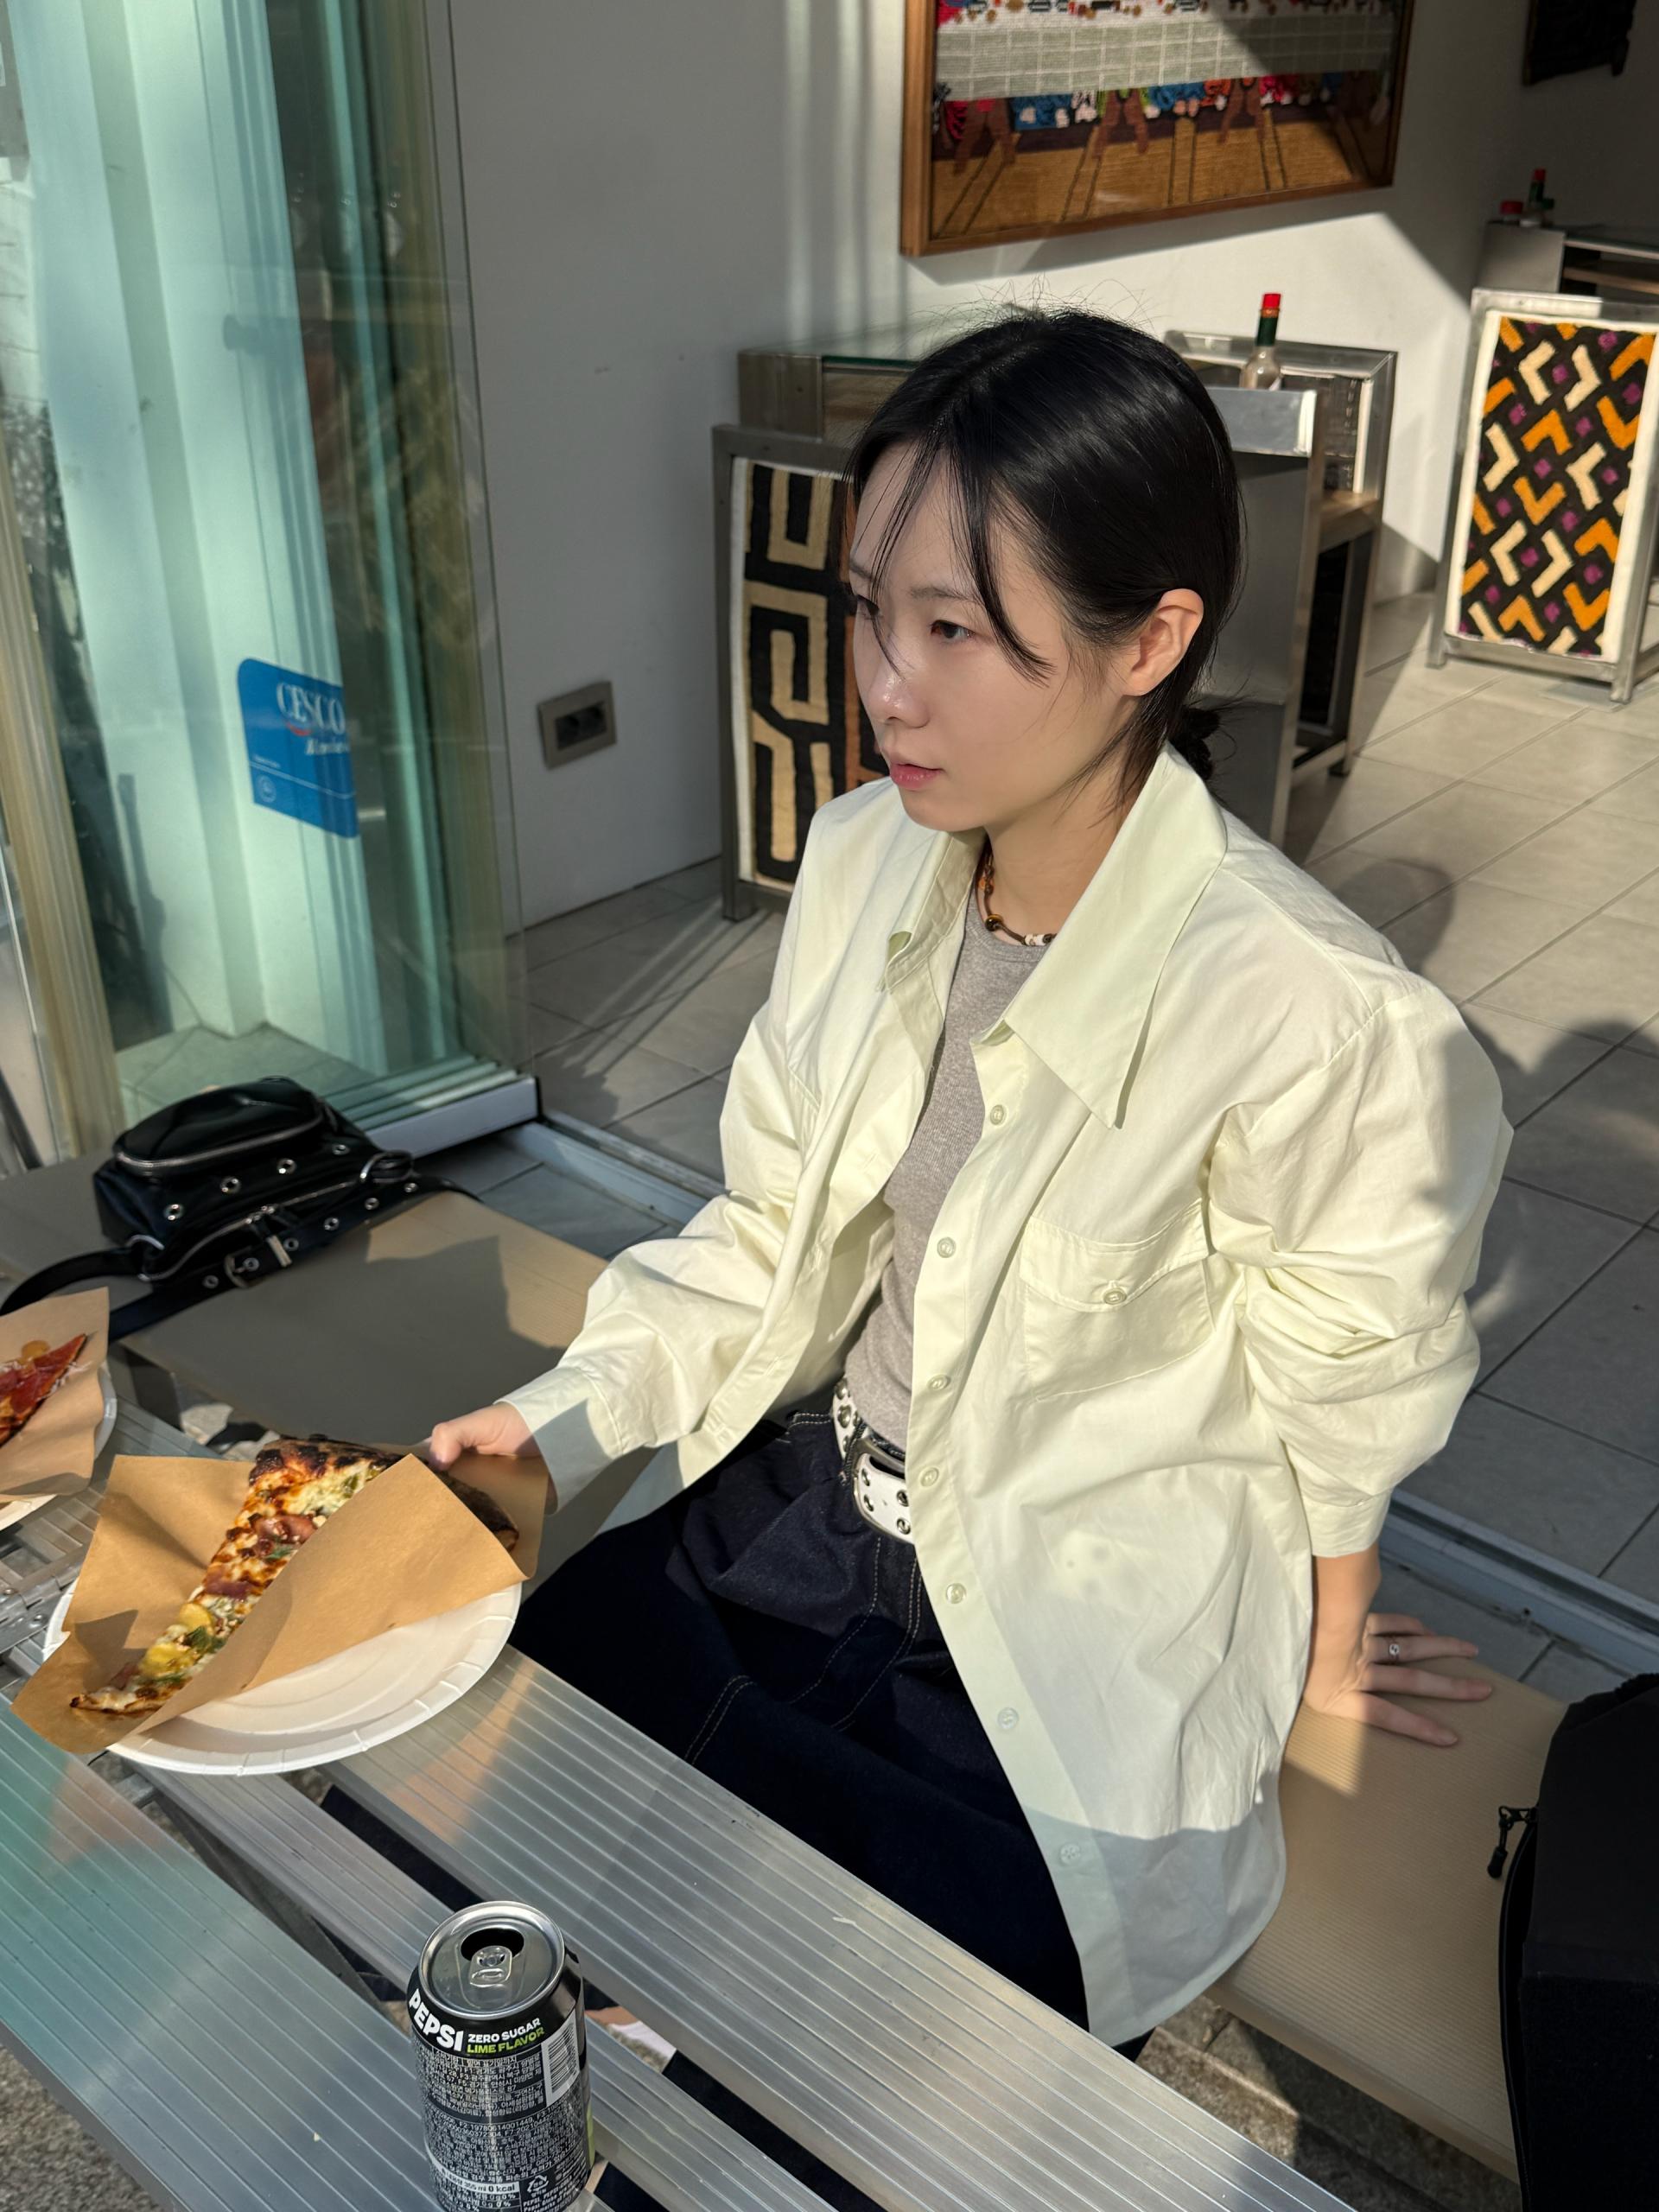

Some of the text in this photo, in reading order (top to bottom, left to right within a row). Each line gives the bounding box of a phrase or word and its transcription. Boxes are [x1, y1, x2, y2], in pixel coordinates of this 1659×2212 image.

[276, 683, 346, 734] CESCO
[409, 1988, 463, 2051] PEPSI
[467, 2018, 541, 2044] ZERO SUGAR
[467, 2027, 545, 2054] LIME FLAVOR
[496, 2183, 515, 2192] kcal
